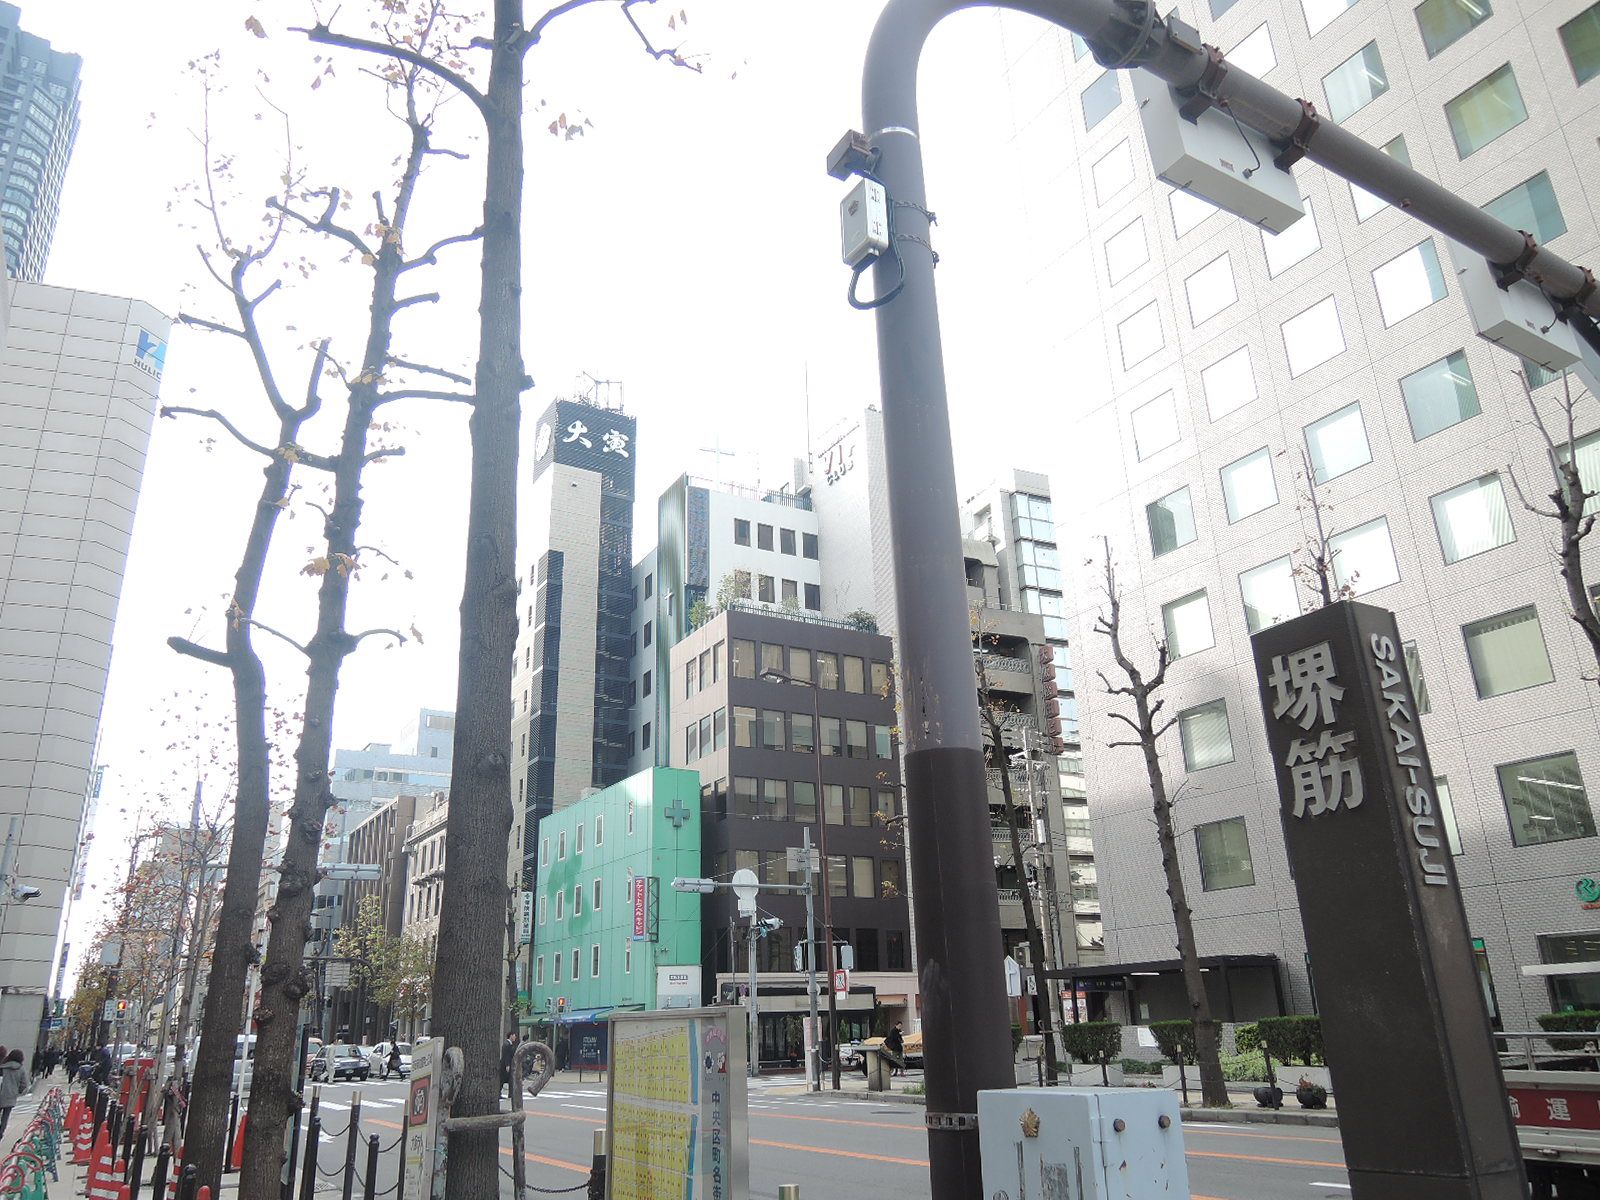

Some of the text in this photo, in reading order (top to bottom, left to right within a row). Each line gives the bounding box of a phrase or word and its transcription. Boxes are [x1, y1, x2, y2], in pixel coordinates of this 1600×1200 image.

[133, 358, 162, 380] HULIC
[1268, 640, 1365, 819] 堺筋
[1371, 632, 1449, 886] SAKAI-SUJI
